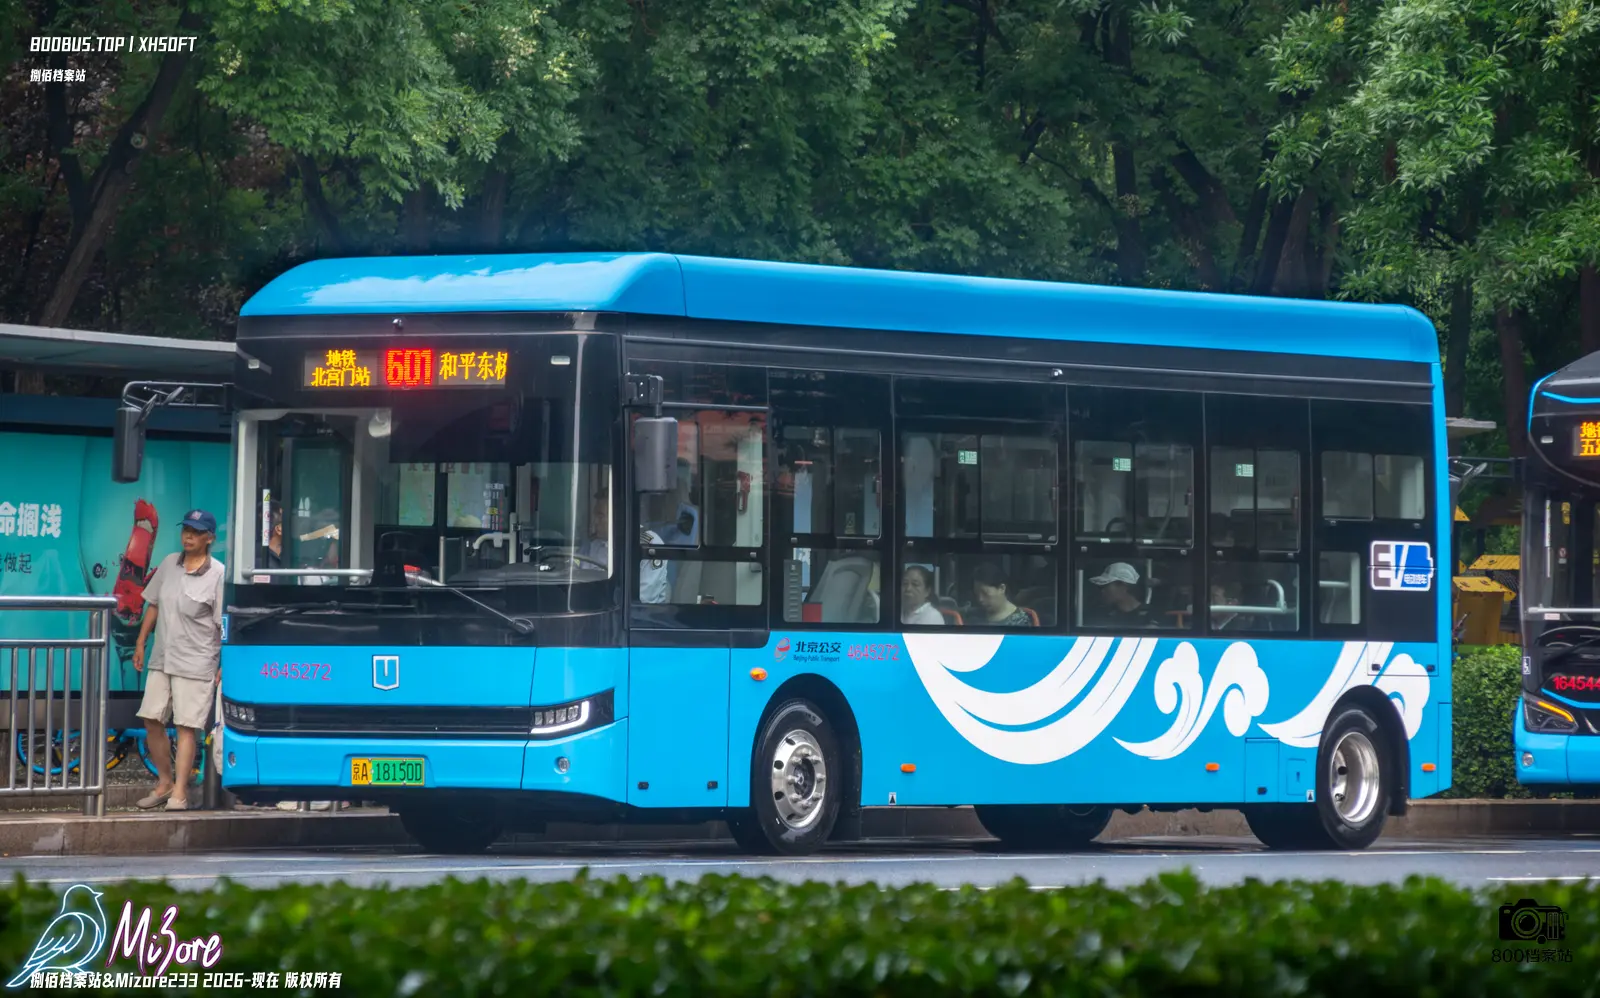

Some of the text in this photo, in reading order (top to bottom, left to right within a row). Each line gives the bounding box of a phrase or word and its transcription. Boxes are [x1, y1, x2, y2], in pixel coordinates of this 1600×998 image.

[326, 349, 357, 368] 地铁
[386, 348, 432, 386] 601
[1580, 438, 1600, 457] 五
[0, 552, 32, 574] 做起
[794, 640, 842, 654] 北京公交
[847, 643, 900, 661] 4645272
[259, 662, 332, 681] 4645272
